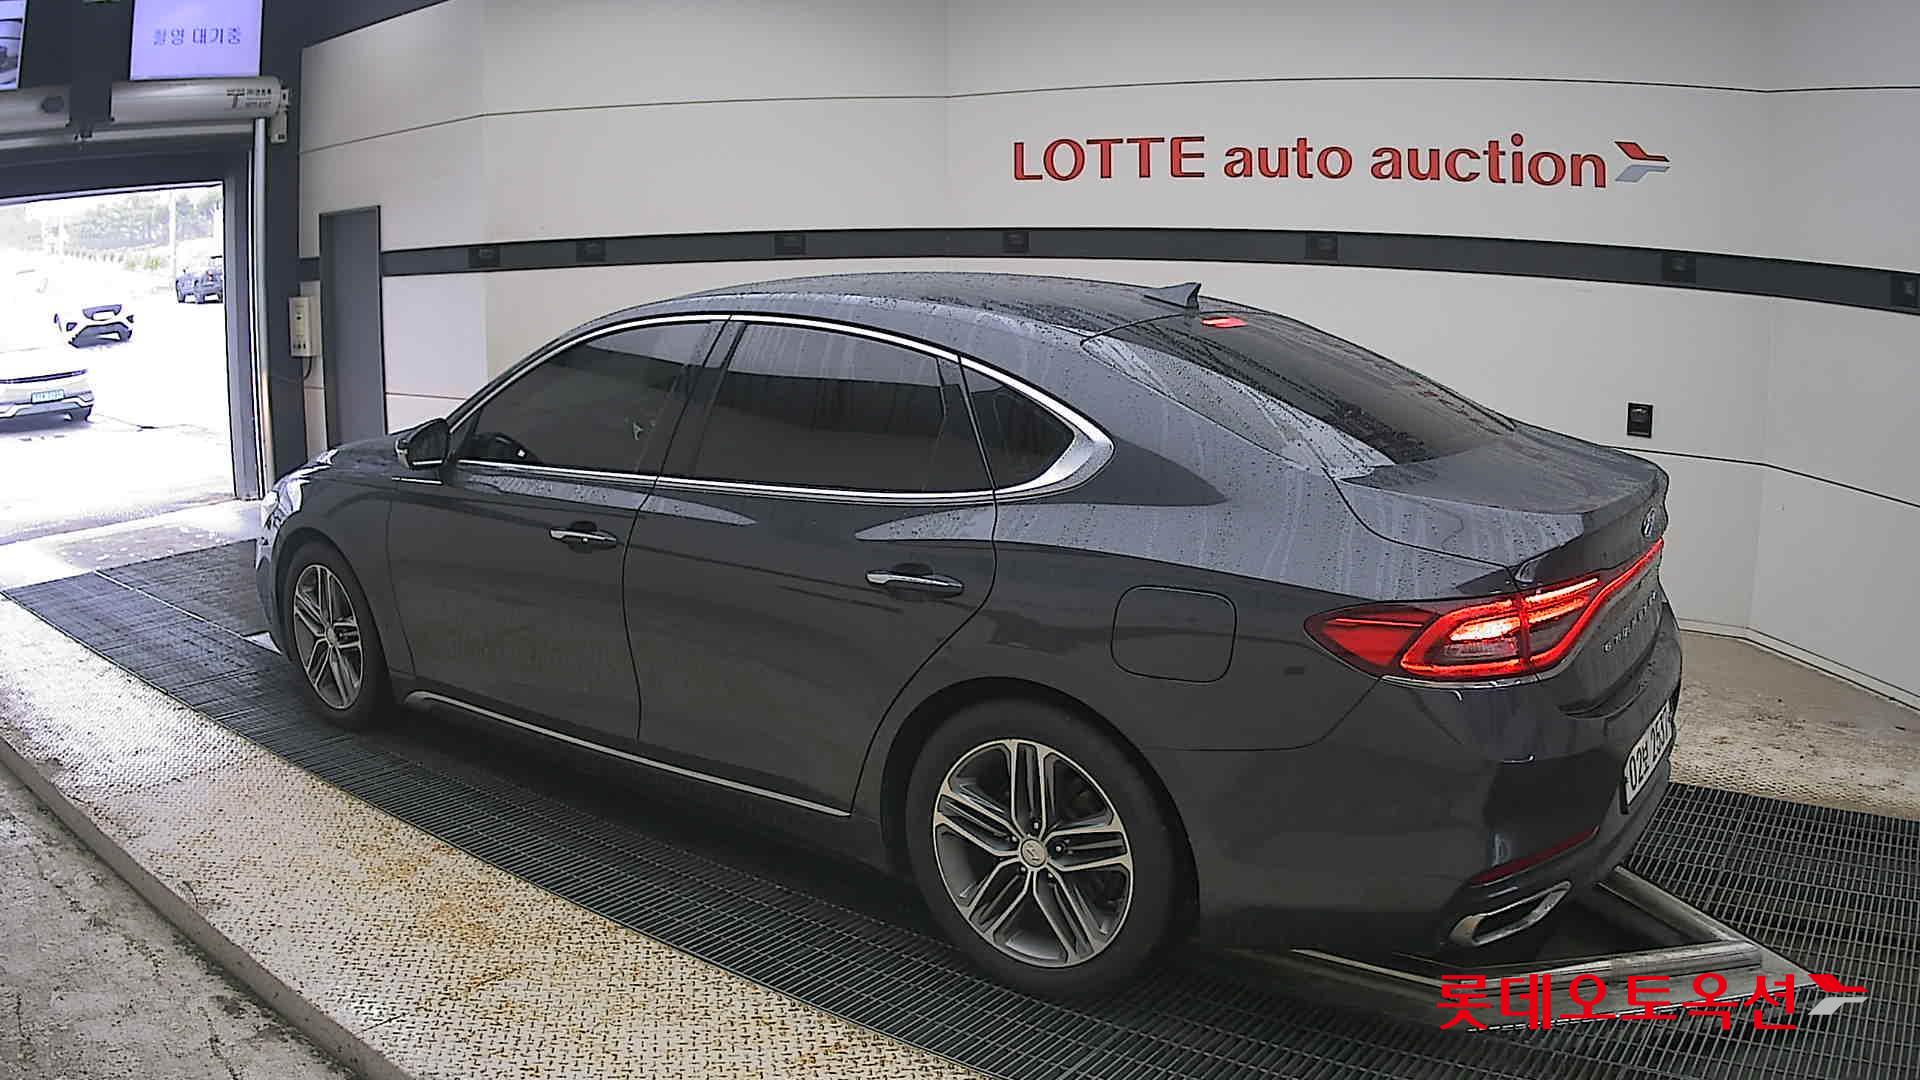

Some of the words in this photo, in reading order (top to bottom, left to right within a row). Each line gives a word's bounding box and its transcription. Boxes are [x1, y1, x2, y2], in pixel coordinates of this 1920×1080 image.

[1013, 136, 1205, 181] LOTTE
[1223, 137, 1354, 179] auto
[1370, 133, 1607, 189] auction
